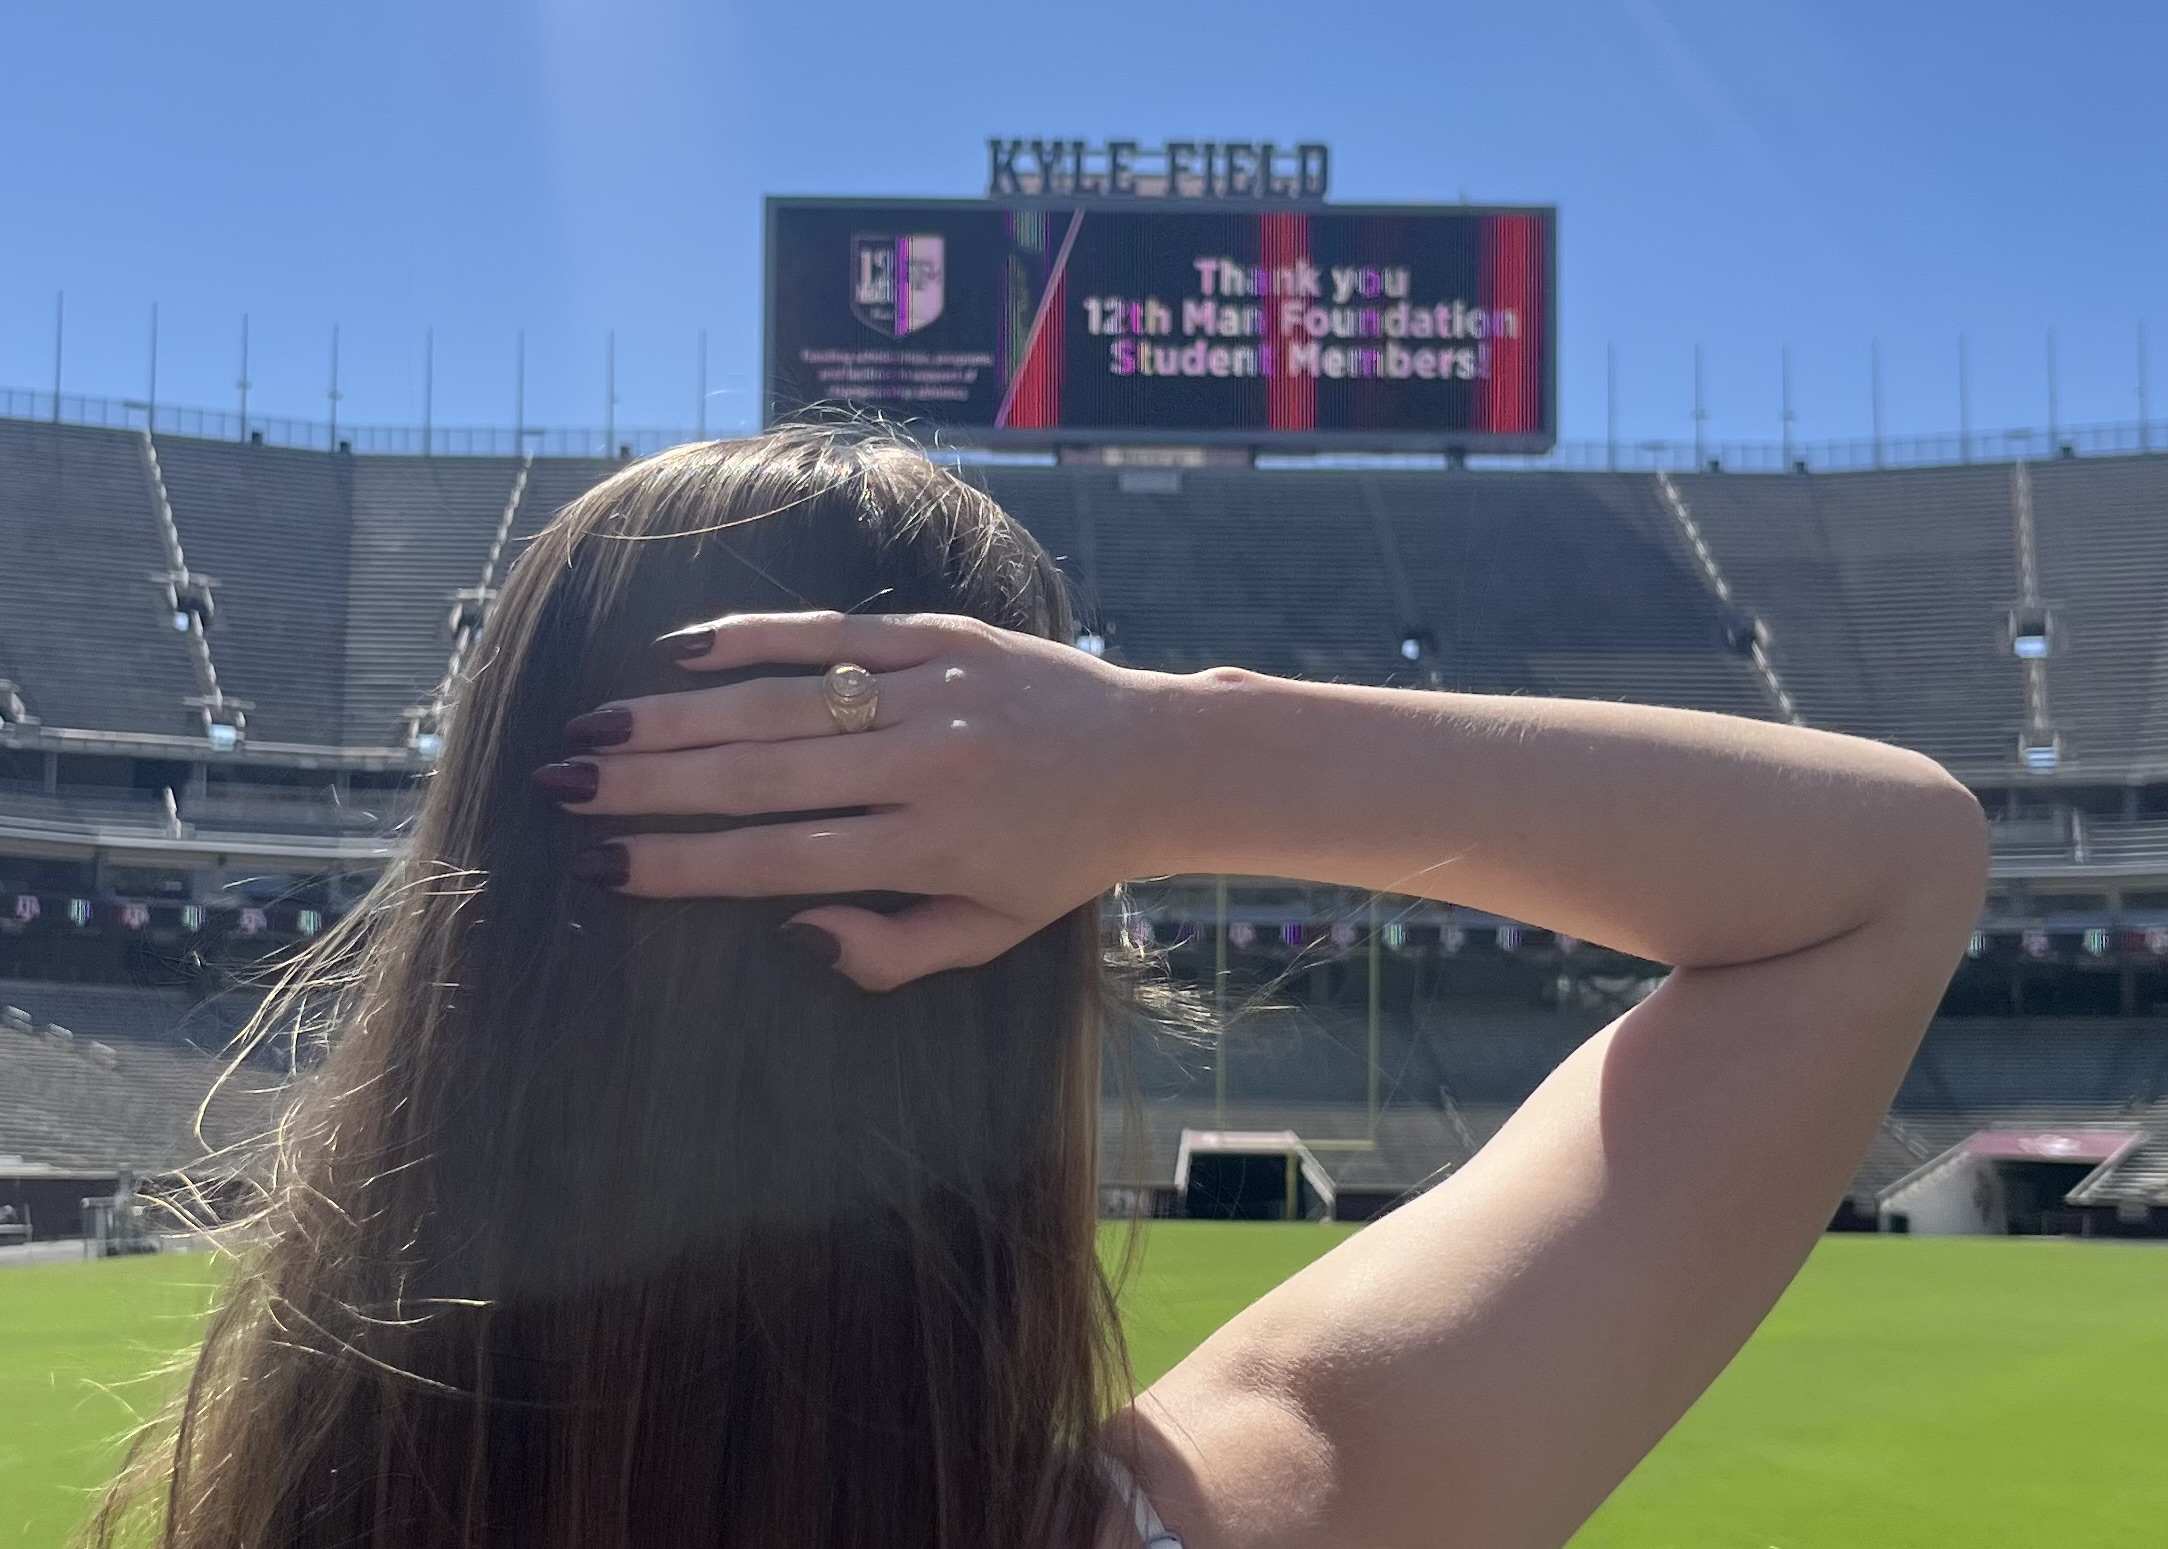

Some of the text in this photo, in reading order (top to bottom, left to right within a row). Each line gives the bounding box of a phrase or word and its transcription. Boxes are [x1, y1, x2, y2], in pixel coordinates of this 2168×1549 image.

[989, 140, 1329, 198] KYLE FIELD
[1193, 257, 1410, 304] Thank you
[1084, 296, 1521, 339] 12th Man Foundation
[1110, 338, 1492, 380] Student Members!
